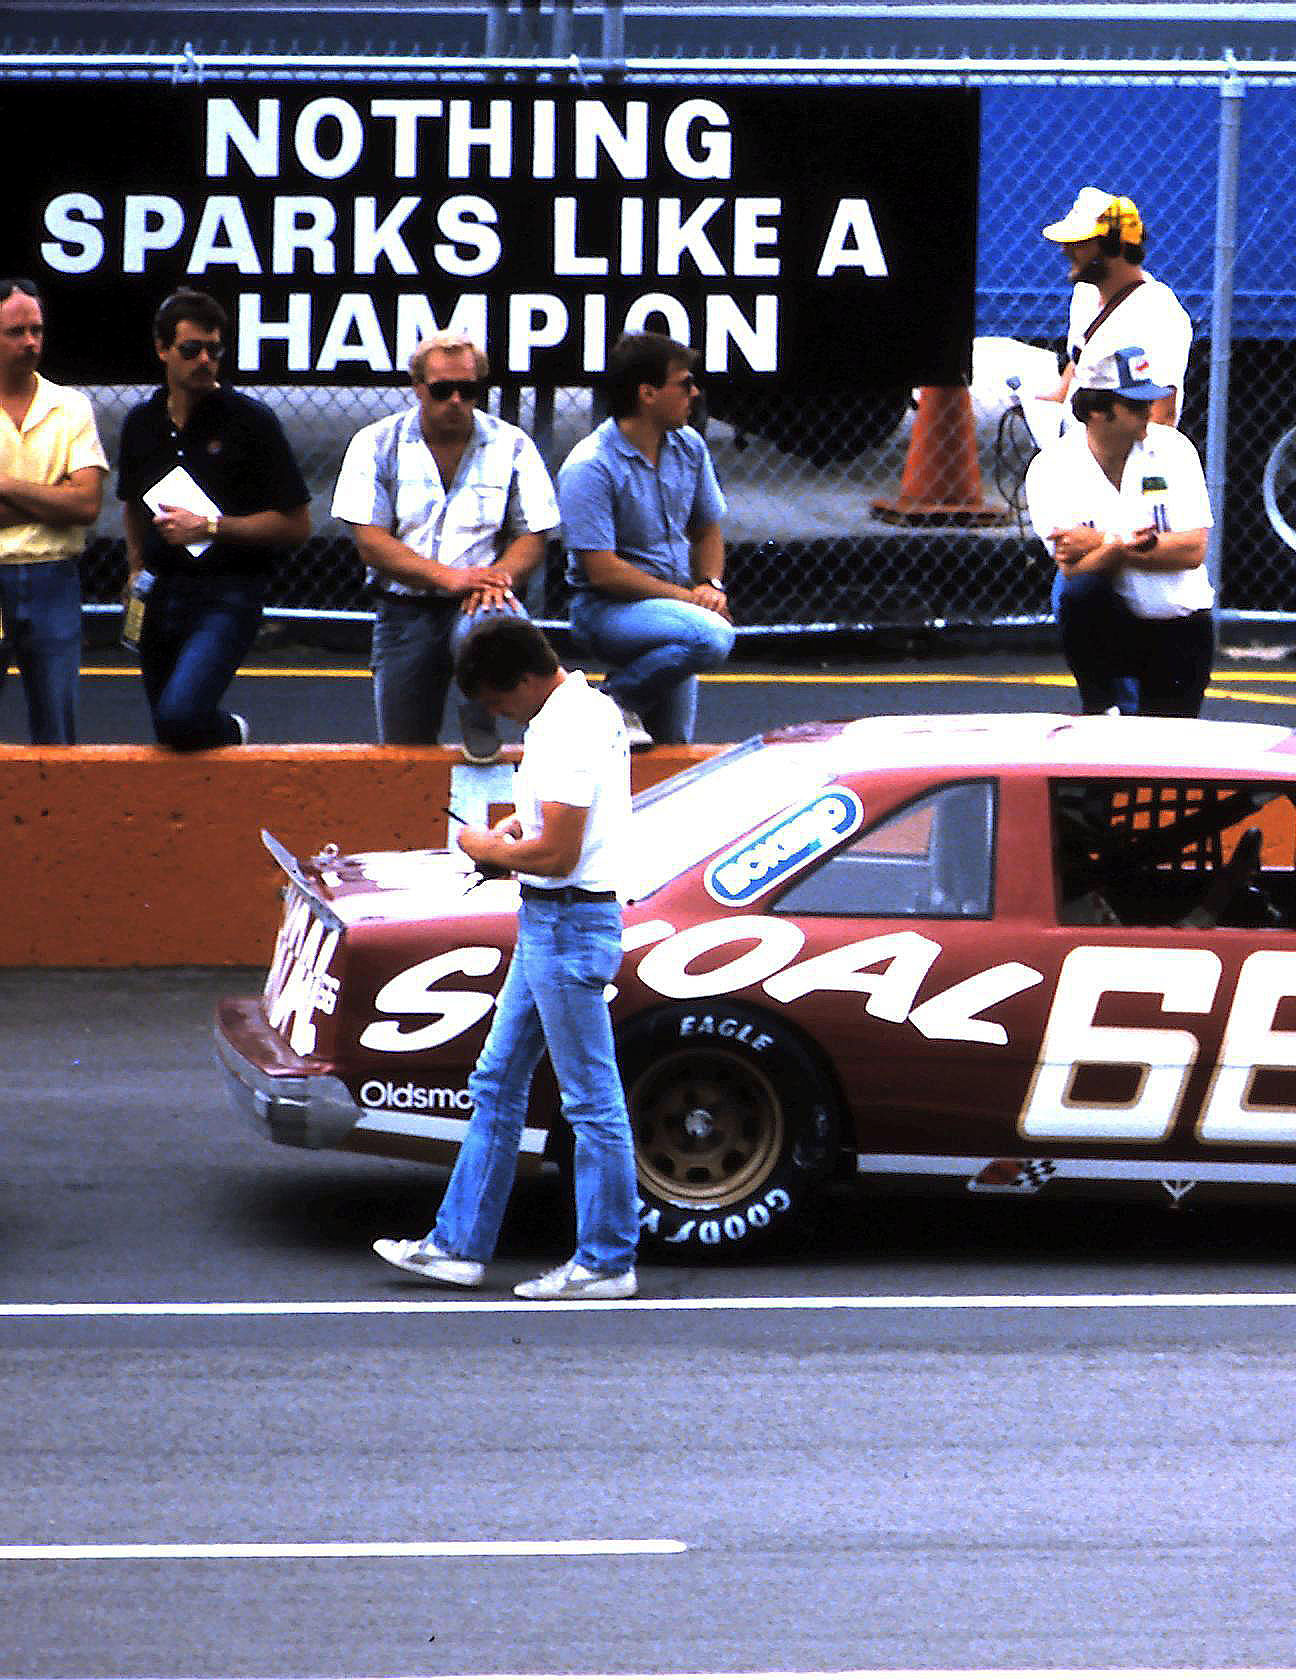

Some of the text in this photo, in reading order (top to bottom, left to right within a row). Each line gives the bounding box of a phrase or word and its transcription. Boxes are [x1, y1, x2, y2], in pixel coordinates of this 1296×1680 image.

[206, 97, 733, 181] NOTHING
[40, 193, 889, 277] SPARKS LIKE A
[237, 292, 779, 374] HAMPION
[360, 914, 1044, 1052] SOAL
[680, 1015, 774, 1052] EAGLE
[361, 1081, 474, 1109] Oldsmo
